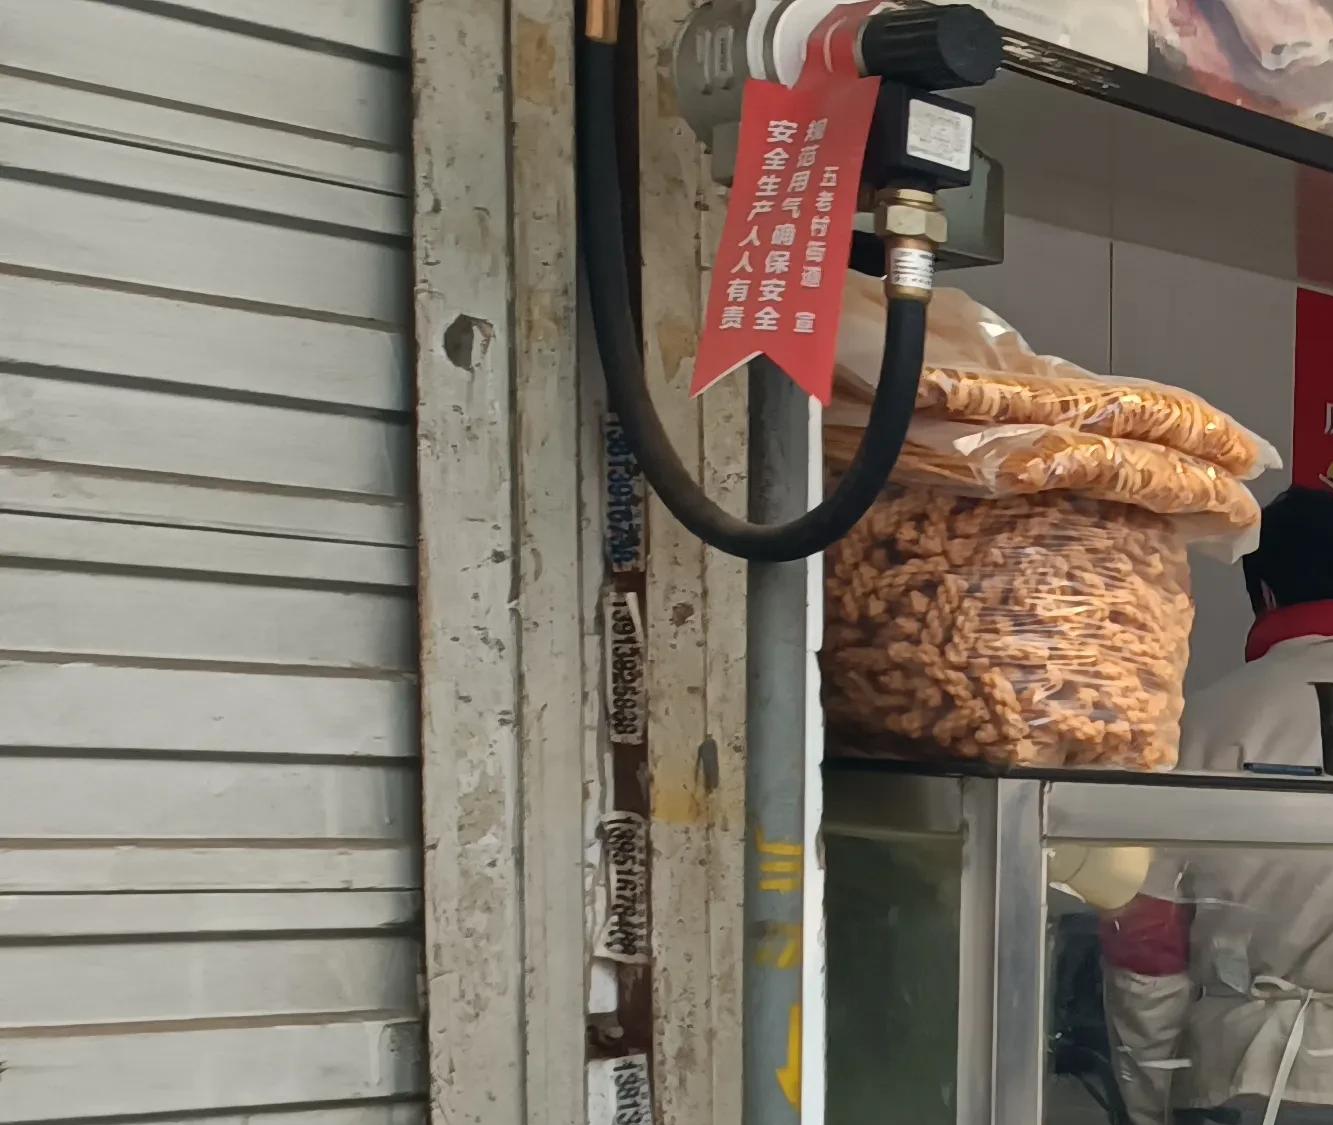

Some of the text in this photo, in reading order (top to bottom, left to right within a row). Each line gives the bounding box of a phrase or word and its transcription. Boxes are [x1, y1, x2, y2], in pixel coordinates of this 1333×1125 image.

[719, 120, 799, 329] 安全生产人人有责
[753, 118, 828, 331] 规范用气确保安全
